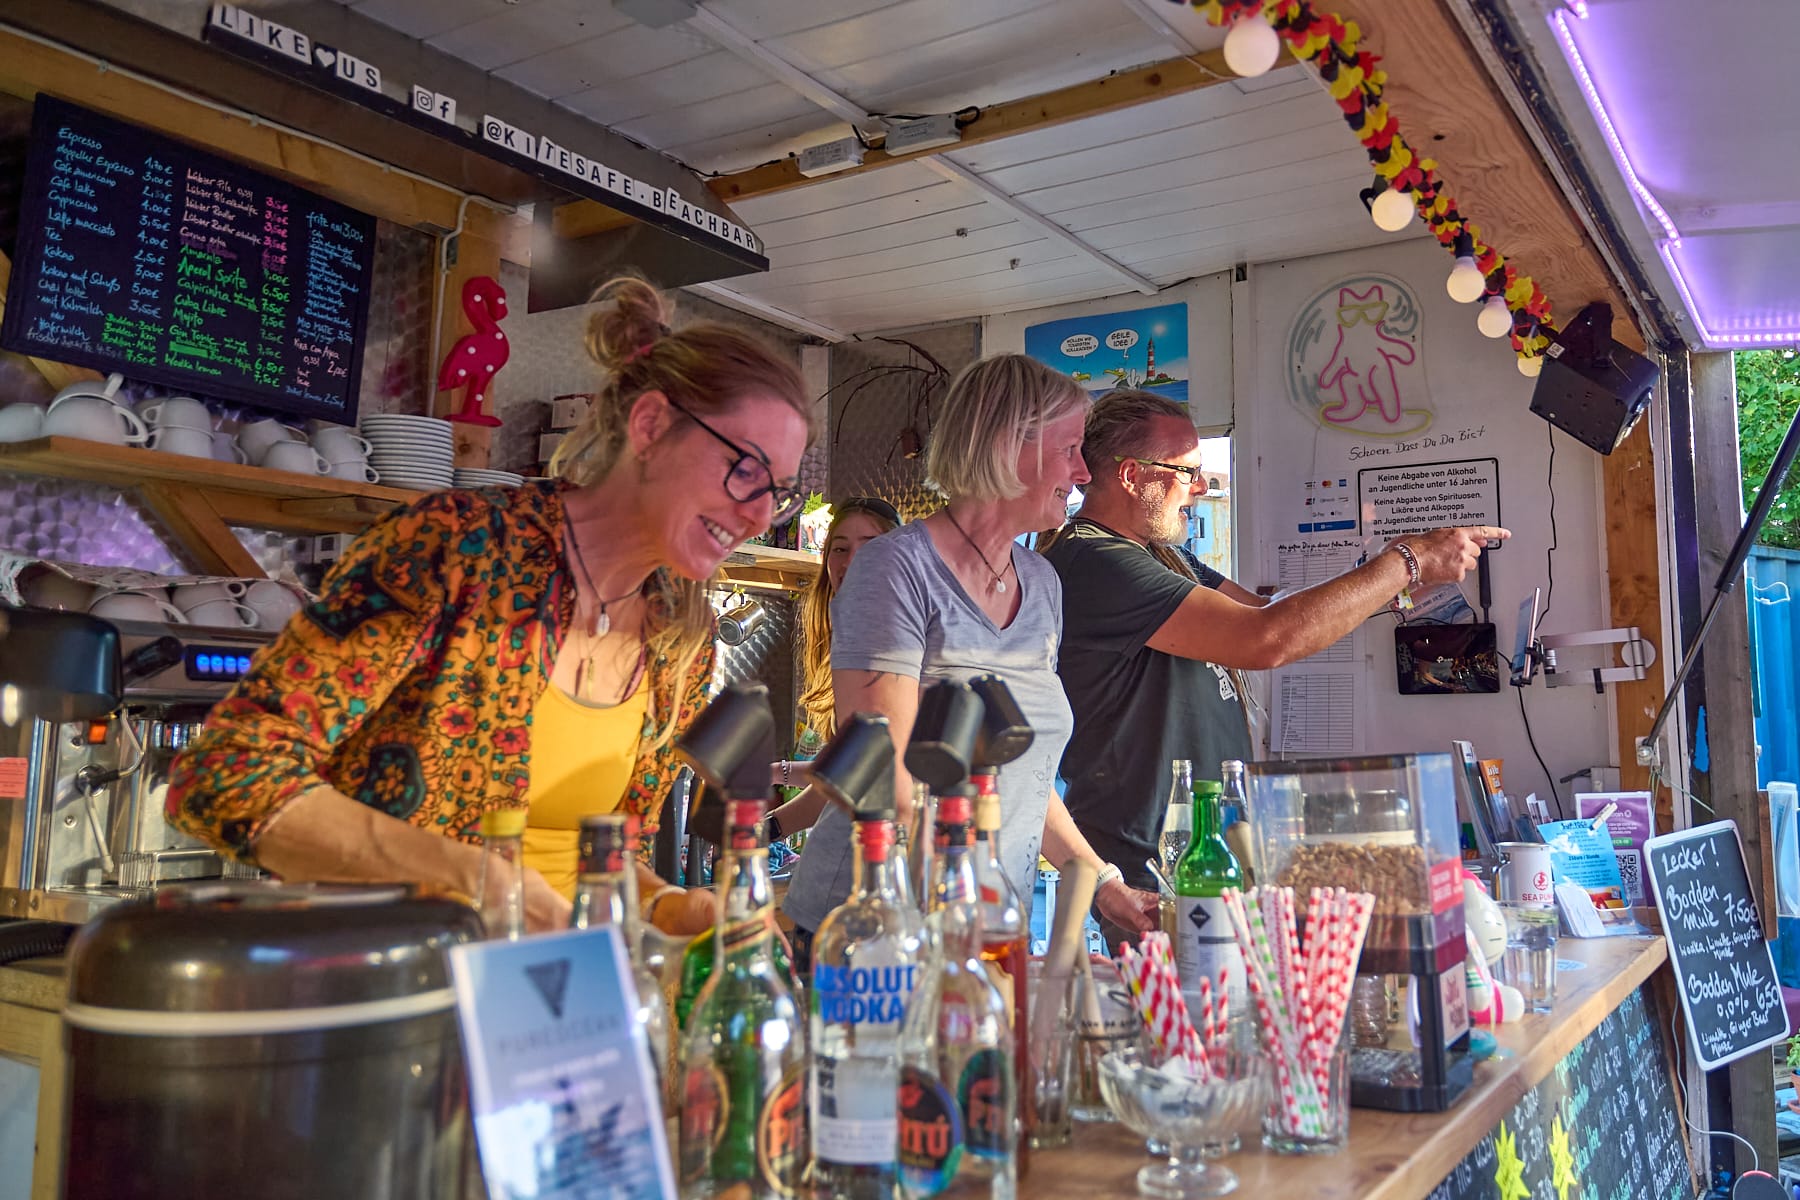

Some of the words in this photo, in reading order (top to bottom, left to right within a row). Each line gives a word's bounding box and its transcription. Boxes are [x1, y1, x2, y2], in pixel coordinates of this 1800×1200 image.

[218, 7, 307, 57] LIKE
[342, 62, 380, 89] US
[58, 128, 102, 149] Espresso
[96, 156, 135, 176] Espresso
[177, 255, 212, 280] Aperol
[1348, 445, 1391, 461] Schoen
[1395, 442, 1418, 454] Dass
[1424, 438, 1437, 448] Du
[1378, 473, 1399, 482] Keine
[1401, 471, 1430, 481] Abgabe
[1431, 470, 1445, 478] von
[1447, 467, 1477, 476] Alkohol
[1380, 481, 1425, 493] Jugendliche
[1426, 480, 1447, 488] unter
[1449, 478, 1458, 487] 16
[1460, 477, 1488, 487] Jahren
[1374, 497, 1394, 506] Keine
[1396, 495, 1423, 506] Abgabe
[1424, 494, 1437, 502] von
[1391, 505, 1414, 515] Liköre
[1415, 503, 1430, 513] und
[1431, 502, 1465, 514] Alkopops
[1384, 514, 1426, 526] Jugendliche
[1428, 513, 1447, 521] unter
[1449, 512, 1458, 520] 18
[1459, 511, 1485, 520] Jahren
[1381, 527, 1401, 536] Zweifel
[1401, 527, 1421, 535] werden
[1521, 893, 1538, 901] SEA
[1666, 879, 1720, 921] Bodden
[1684, 909, 1720, 931] Mule
[1687, 970, 1735, 1004] Bodden
[1730, 960, 1765, 992] Mule
[819, 994, 905, 1025] VODKA
